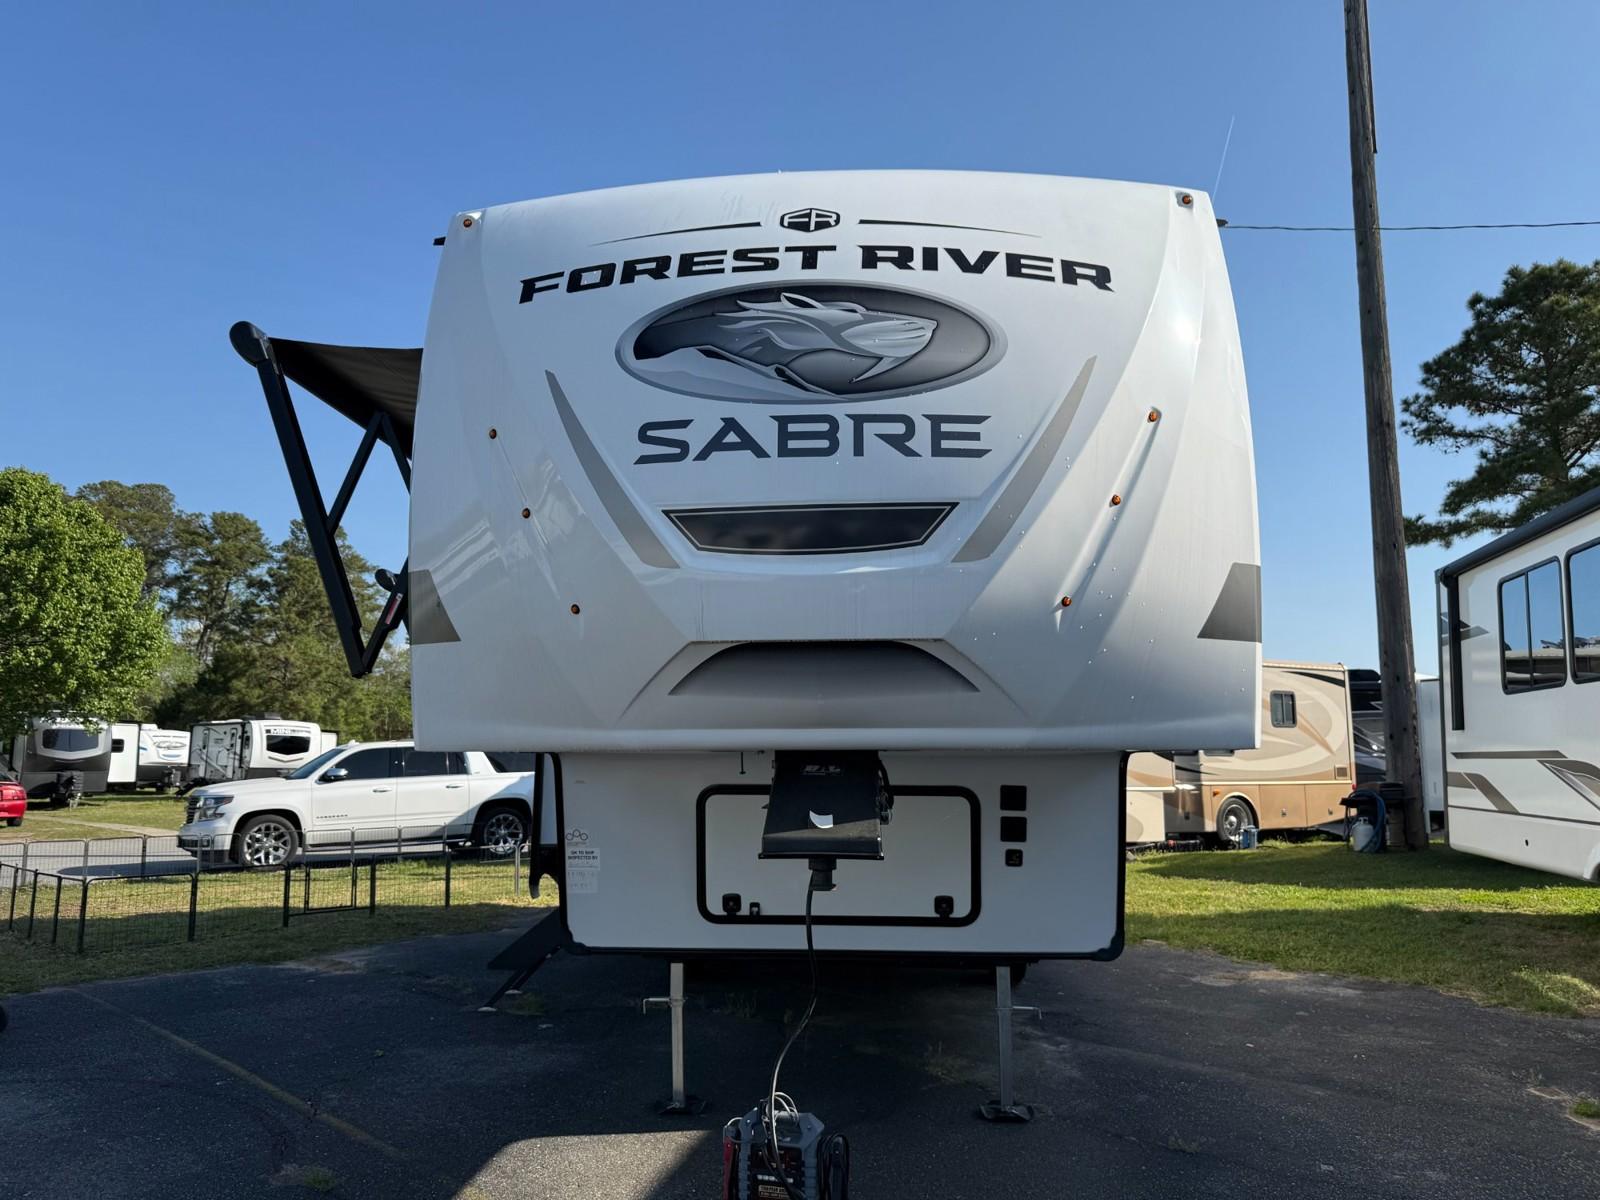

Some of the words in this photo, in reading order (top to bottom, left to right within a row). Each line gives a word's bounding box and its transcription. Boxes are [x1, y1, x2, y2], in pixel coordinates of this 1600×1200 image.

[519, 245, 837, 304] FOREST
[857, 244, 1115, 292] RIVER
[633, 413, 993, 465] SABRE
